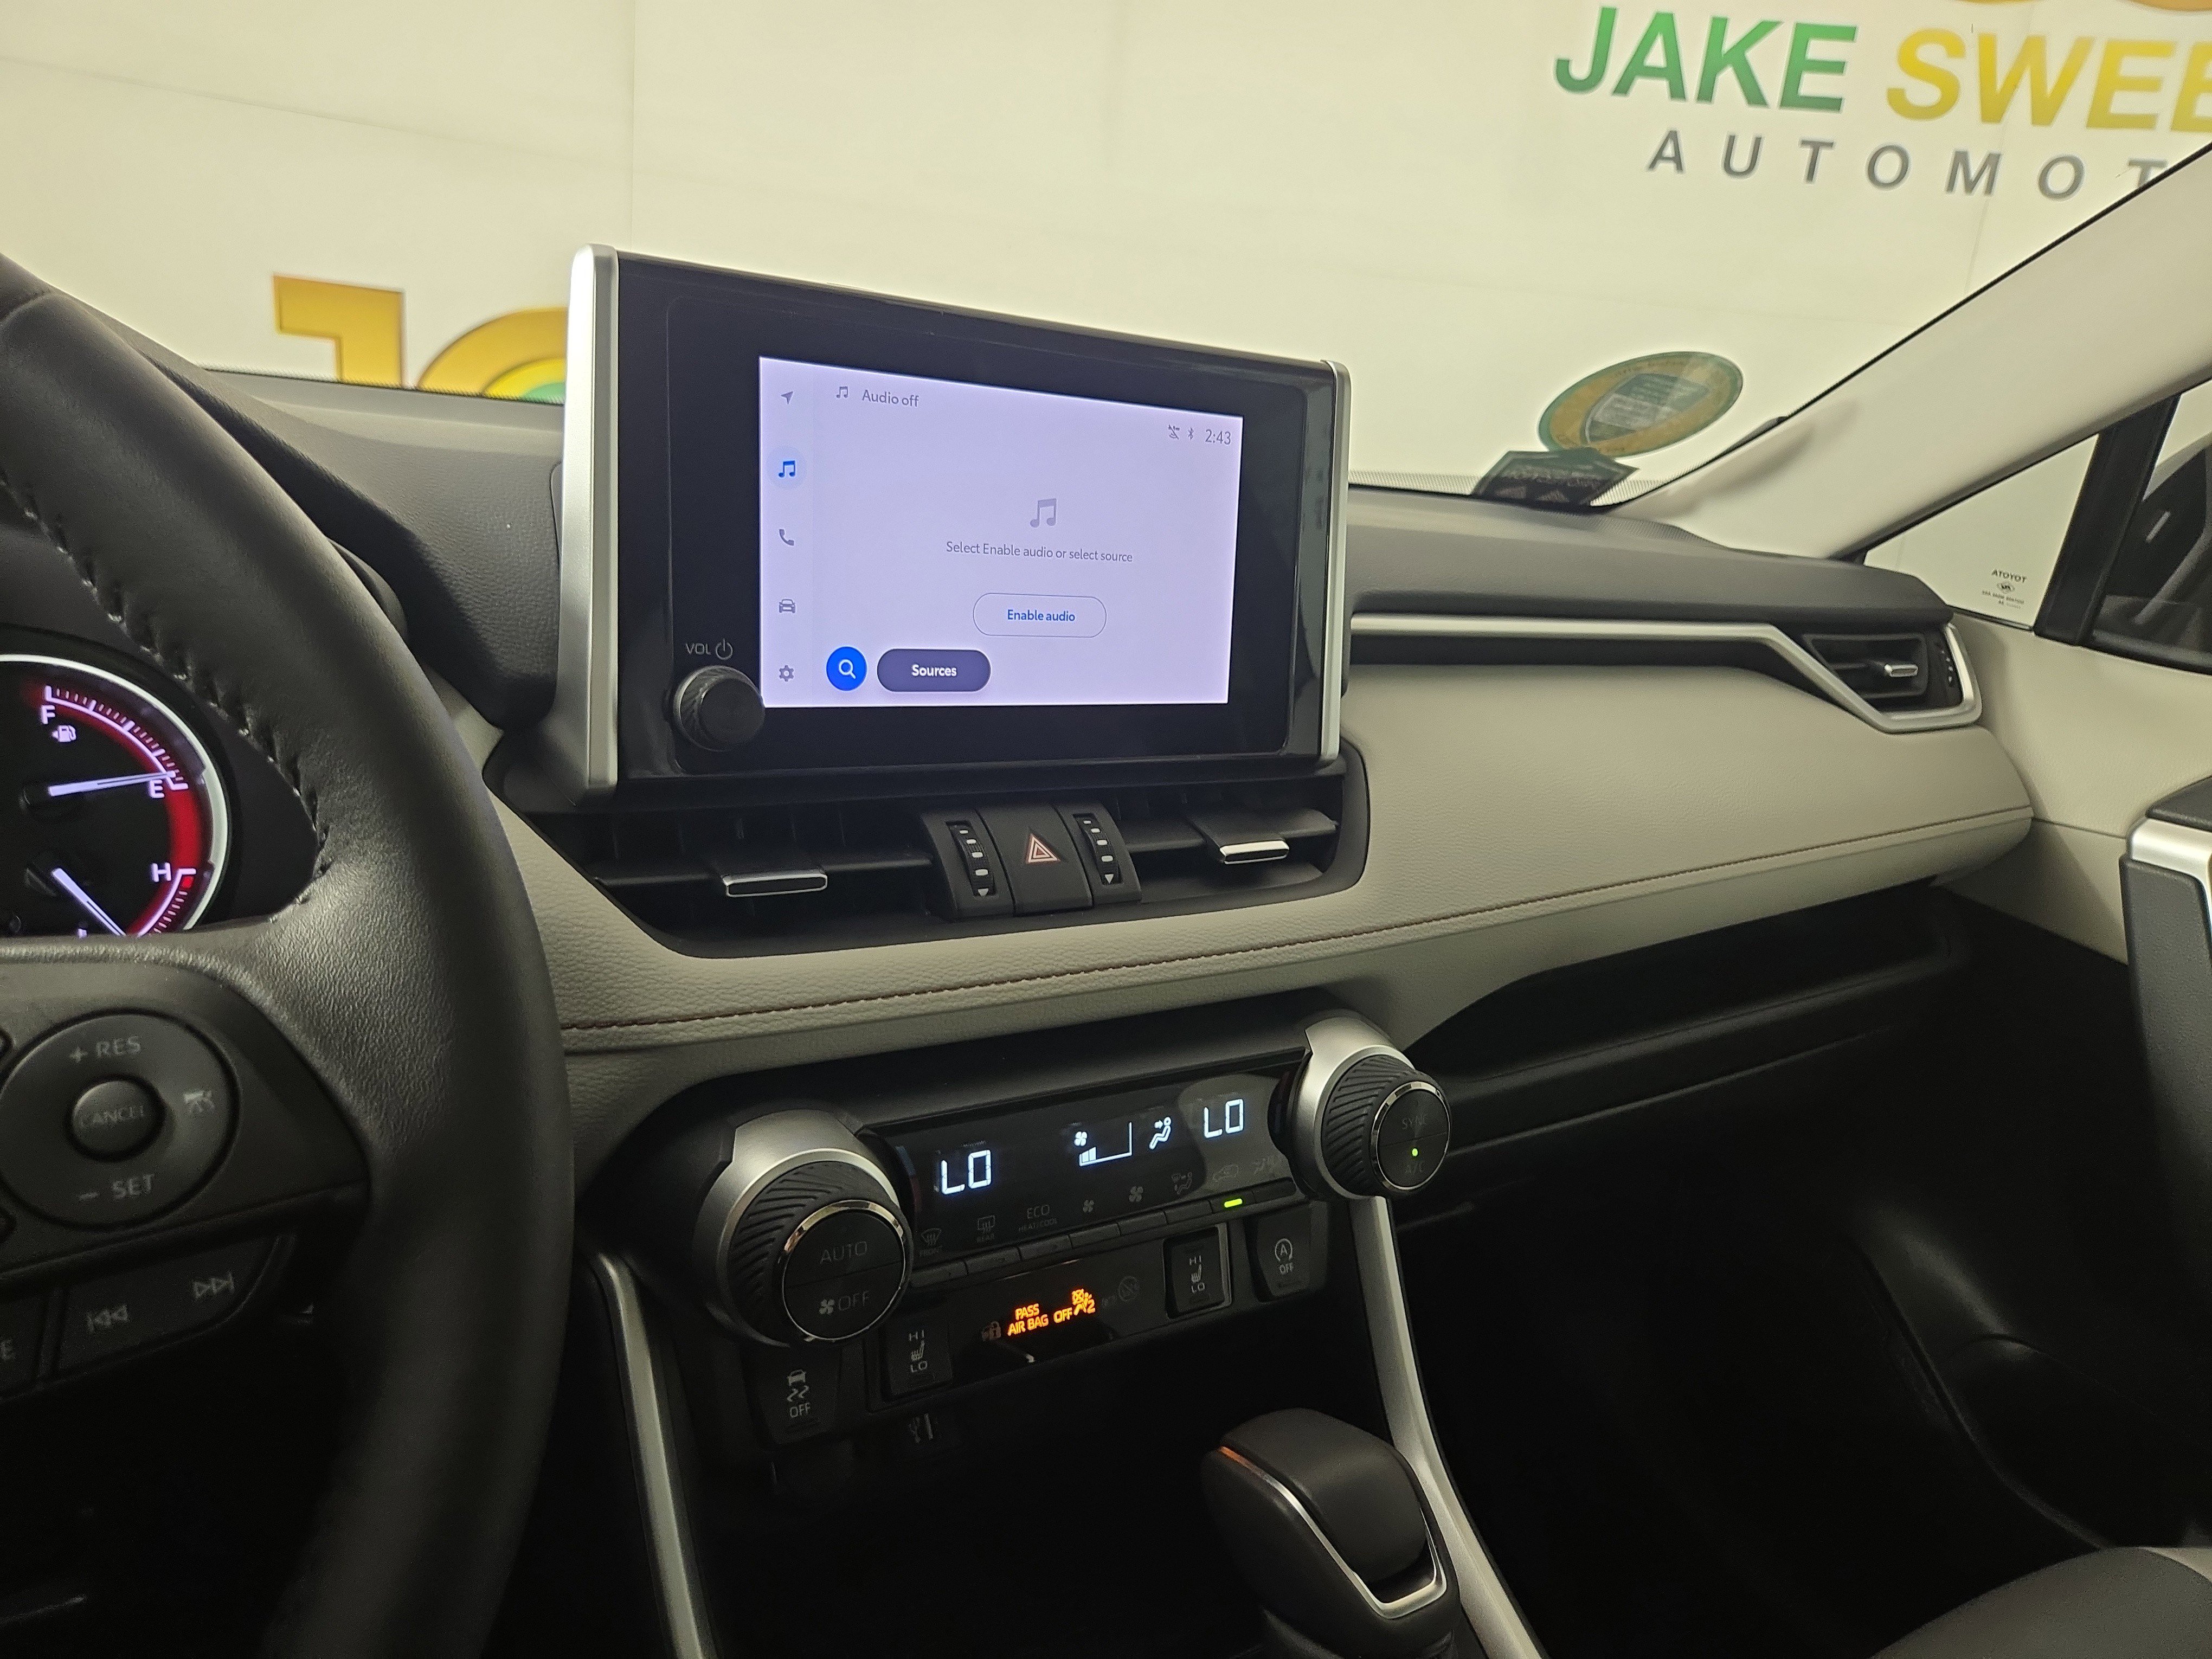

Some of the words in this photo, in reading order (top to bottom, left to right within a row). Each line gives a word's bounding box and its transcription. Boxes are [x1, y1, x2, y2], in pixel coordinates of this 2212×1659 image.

[1554, 5, 1859, 114] JAKE
[862, 390, 899, 406] Audio
[902, 394, 919, 407] off
[1205, 429, 1232, 446] 2:43
[946, 541, 980, 555] Select
[983, 543, 1021, 557] Enable
[1024, 545, 1053, 558] audio
[1056, 549, 1067, 560] or
[1069, 547, 1098, 561] select
[1101, 551, 1134, 563] source
[1006, 608, 1044, 622] Enable
[1046, 610, 1076, 623] audio
[686, 642, 711, 655] VOL
[911, 664, 957, 678] Sources
[41, 705, 55, 724] F
[149, 780, 165, 798] E
[151, 863, 172, 882] H
[95, 1036, 142, 1058] RES
[1204, 1097, 1244, 1139] LO
[941, 1149, 992, 1195] LO
[112, 1174, 155, 1199] SET
[1026, 1204, 1051, 1219] ECO
[819, 1240, 867, 1265] AUTO
[1279, 1262, 1294, 1275] OFF
[1191, 1282, 1205, 1294] LO
[838, 1290, 870, 1312] OFF
[1015, 1303, 1040, 1321] PASS
[1007, 1320, 1026, 1336] AIR
[1027, 1314, 1049, 1330] BAG
[1053, 1307, 1073, 1323] OFF
[908, 1329, 925, 1342] HI
[910, 1360, 928, 1373] LO
[789, 1402, 811, 1418] OFF
